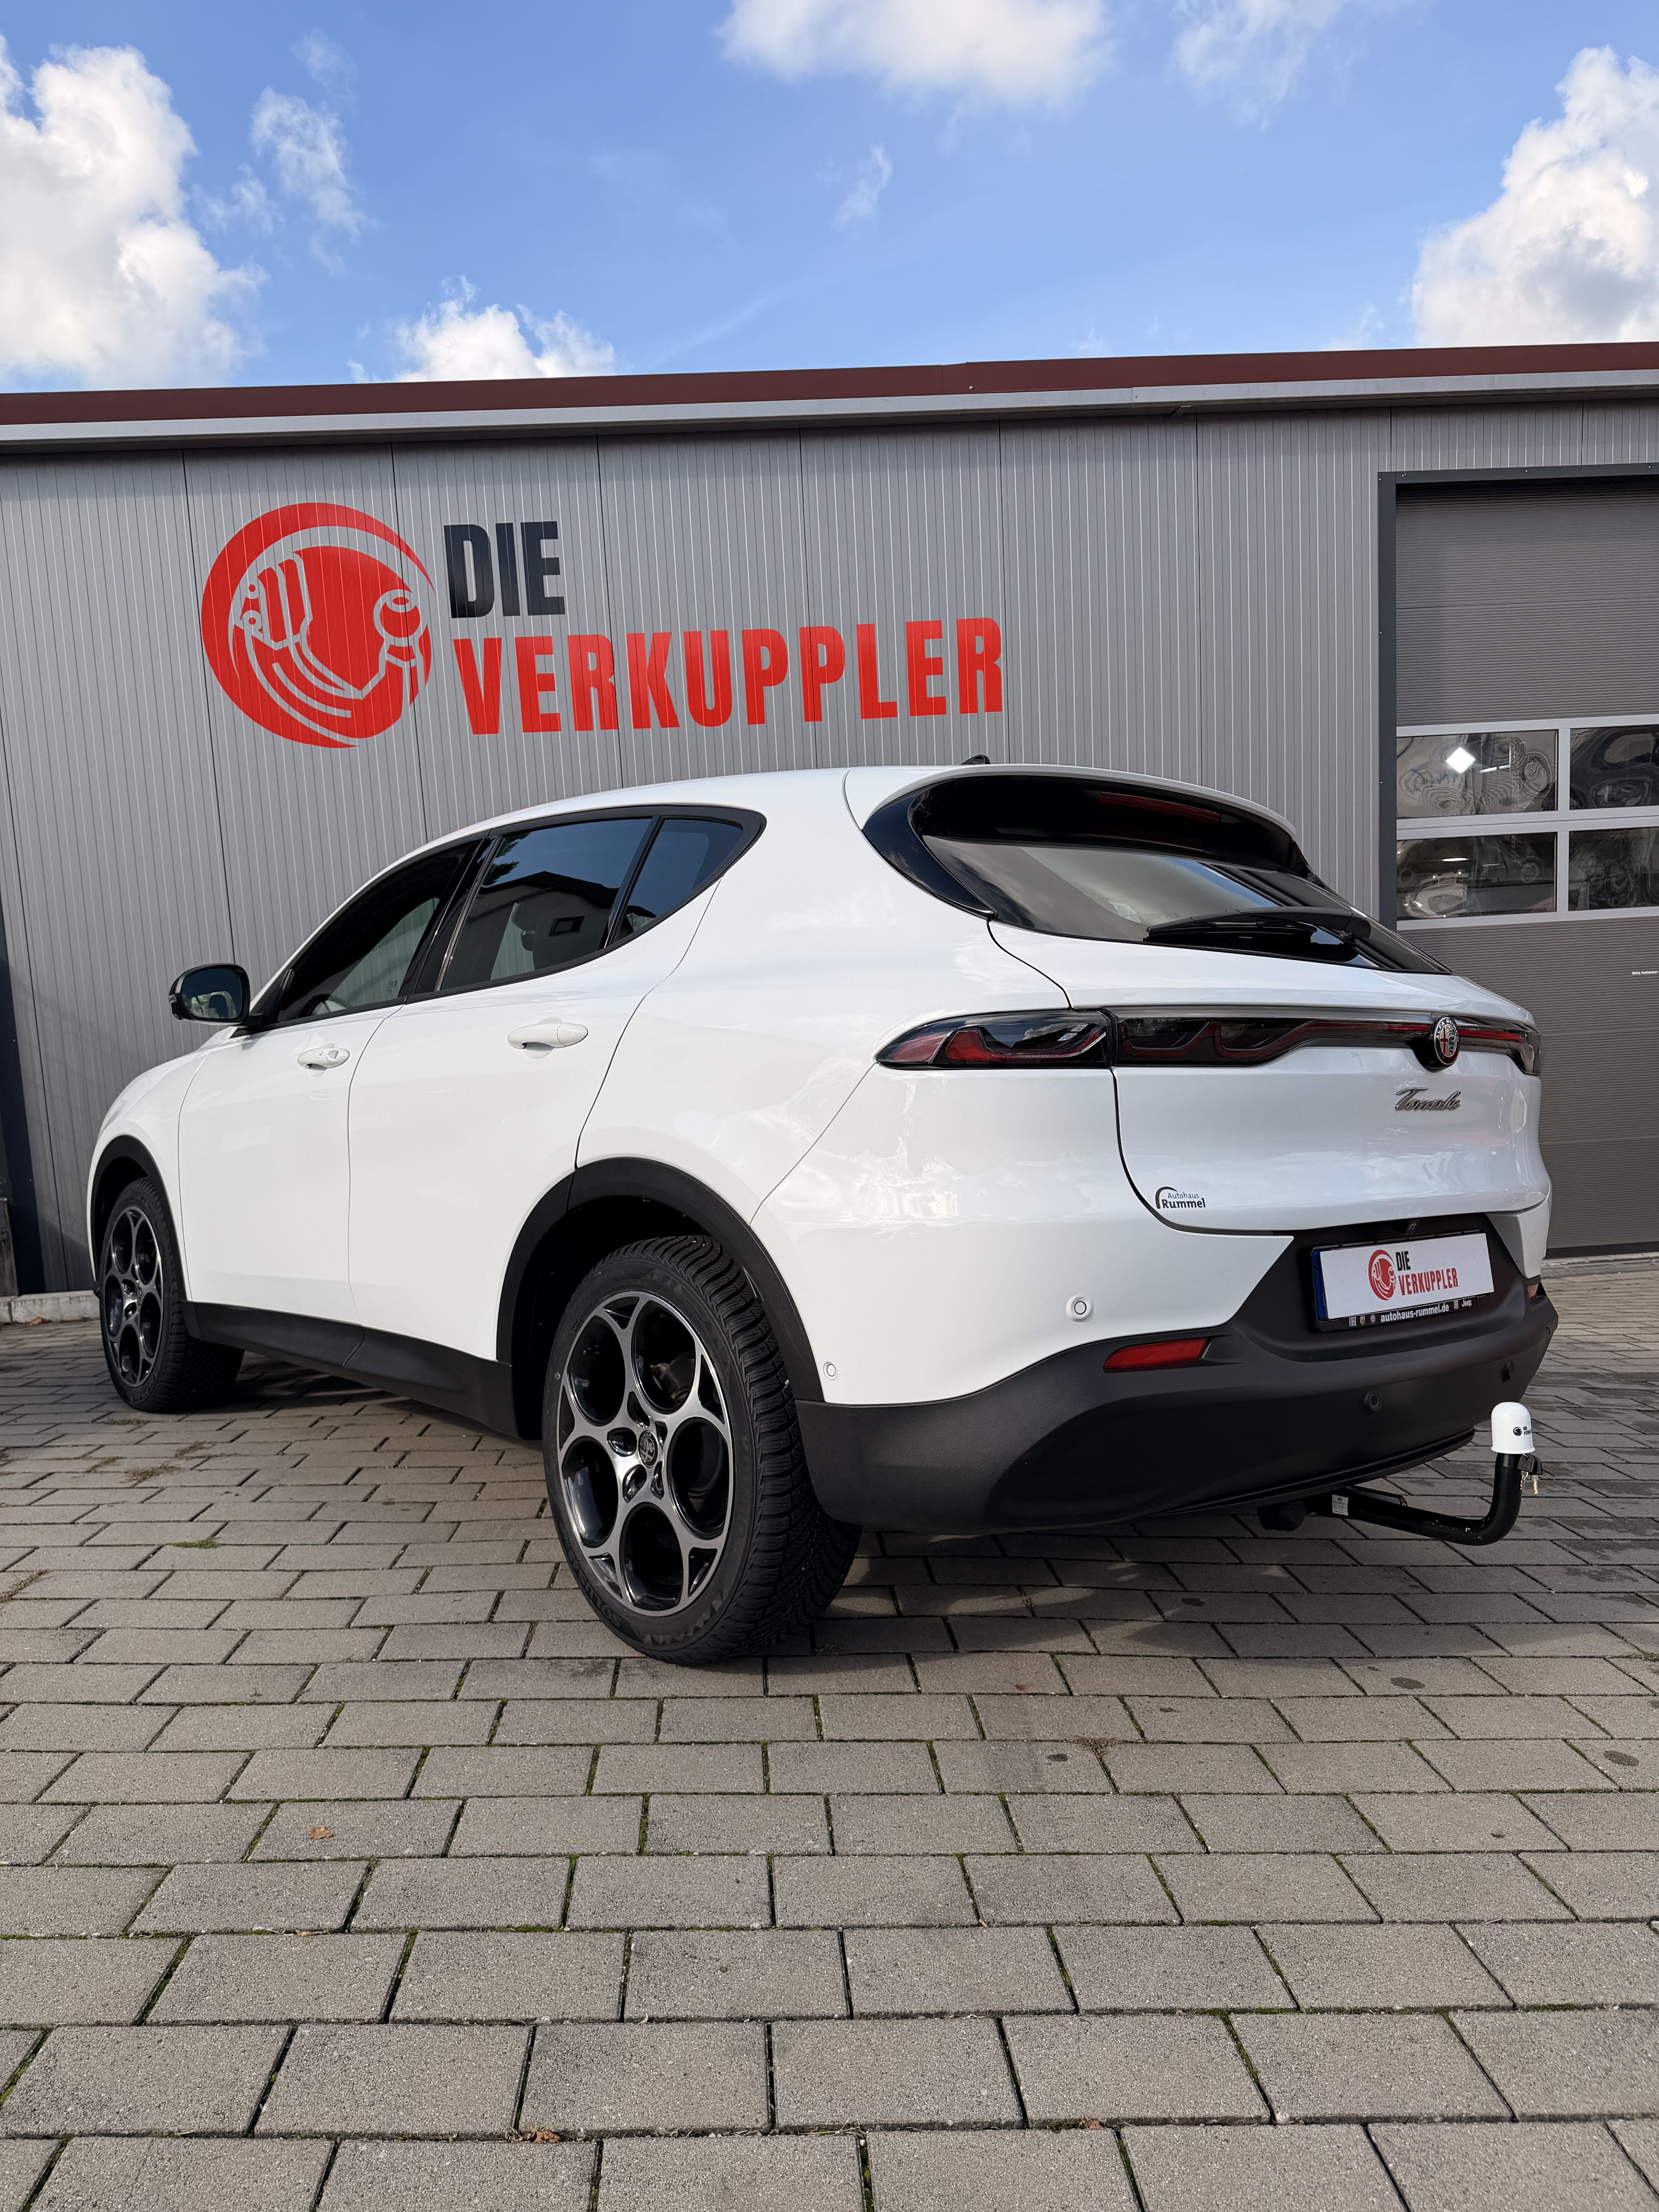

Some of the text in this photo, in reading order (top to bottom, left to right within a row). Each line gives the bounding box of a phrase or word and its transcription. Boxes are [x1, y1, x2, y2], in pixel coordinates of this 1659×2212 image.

[444, 521, 565, 618] DIE
[453, 617, 1003, 735] VERKUPPLER
[1436, 1021, 1445, 1040] ALFA
[1395, 1087, 1461, 1111] Tonale
[1161, 1198, 1206, 1209] Rummel
[1395, 1251, 1411, 1271] DIE
[1398, 1267, 1458, 1296] VERKUPPLER
[1380, 1302, 1449, 1322] autohaus-rummel.de
[1462, 1299, 1472, 1307] Jeep
[576, 1567, 621, 1628] SOLUS
